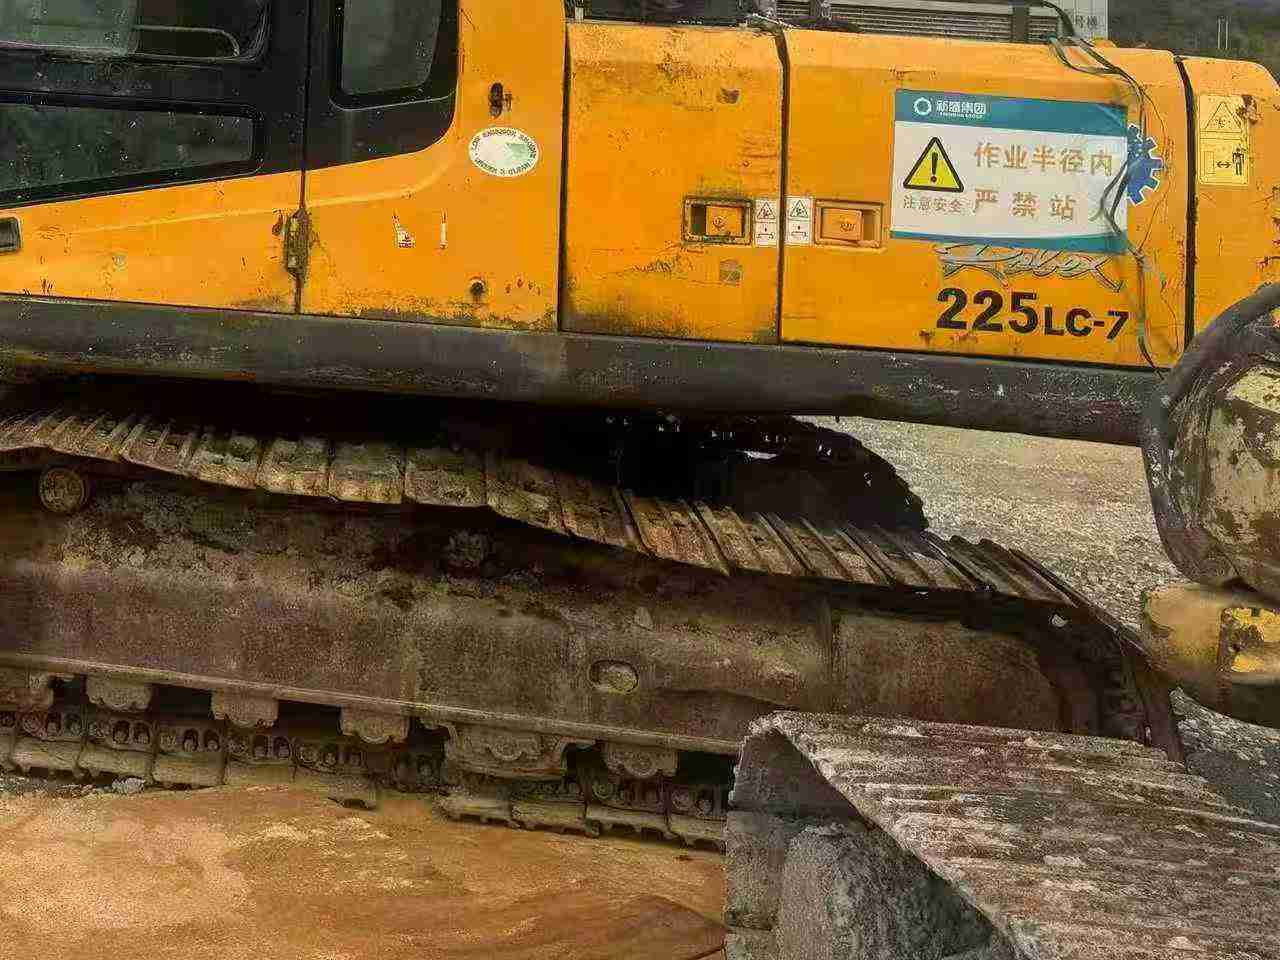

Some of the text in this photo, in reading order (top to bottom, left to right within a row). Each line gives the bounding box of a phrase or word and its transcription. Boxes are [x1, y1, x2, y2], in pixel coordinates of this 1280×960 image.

[974, 141, 1114, 177] 作业半径内
